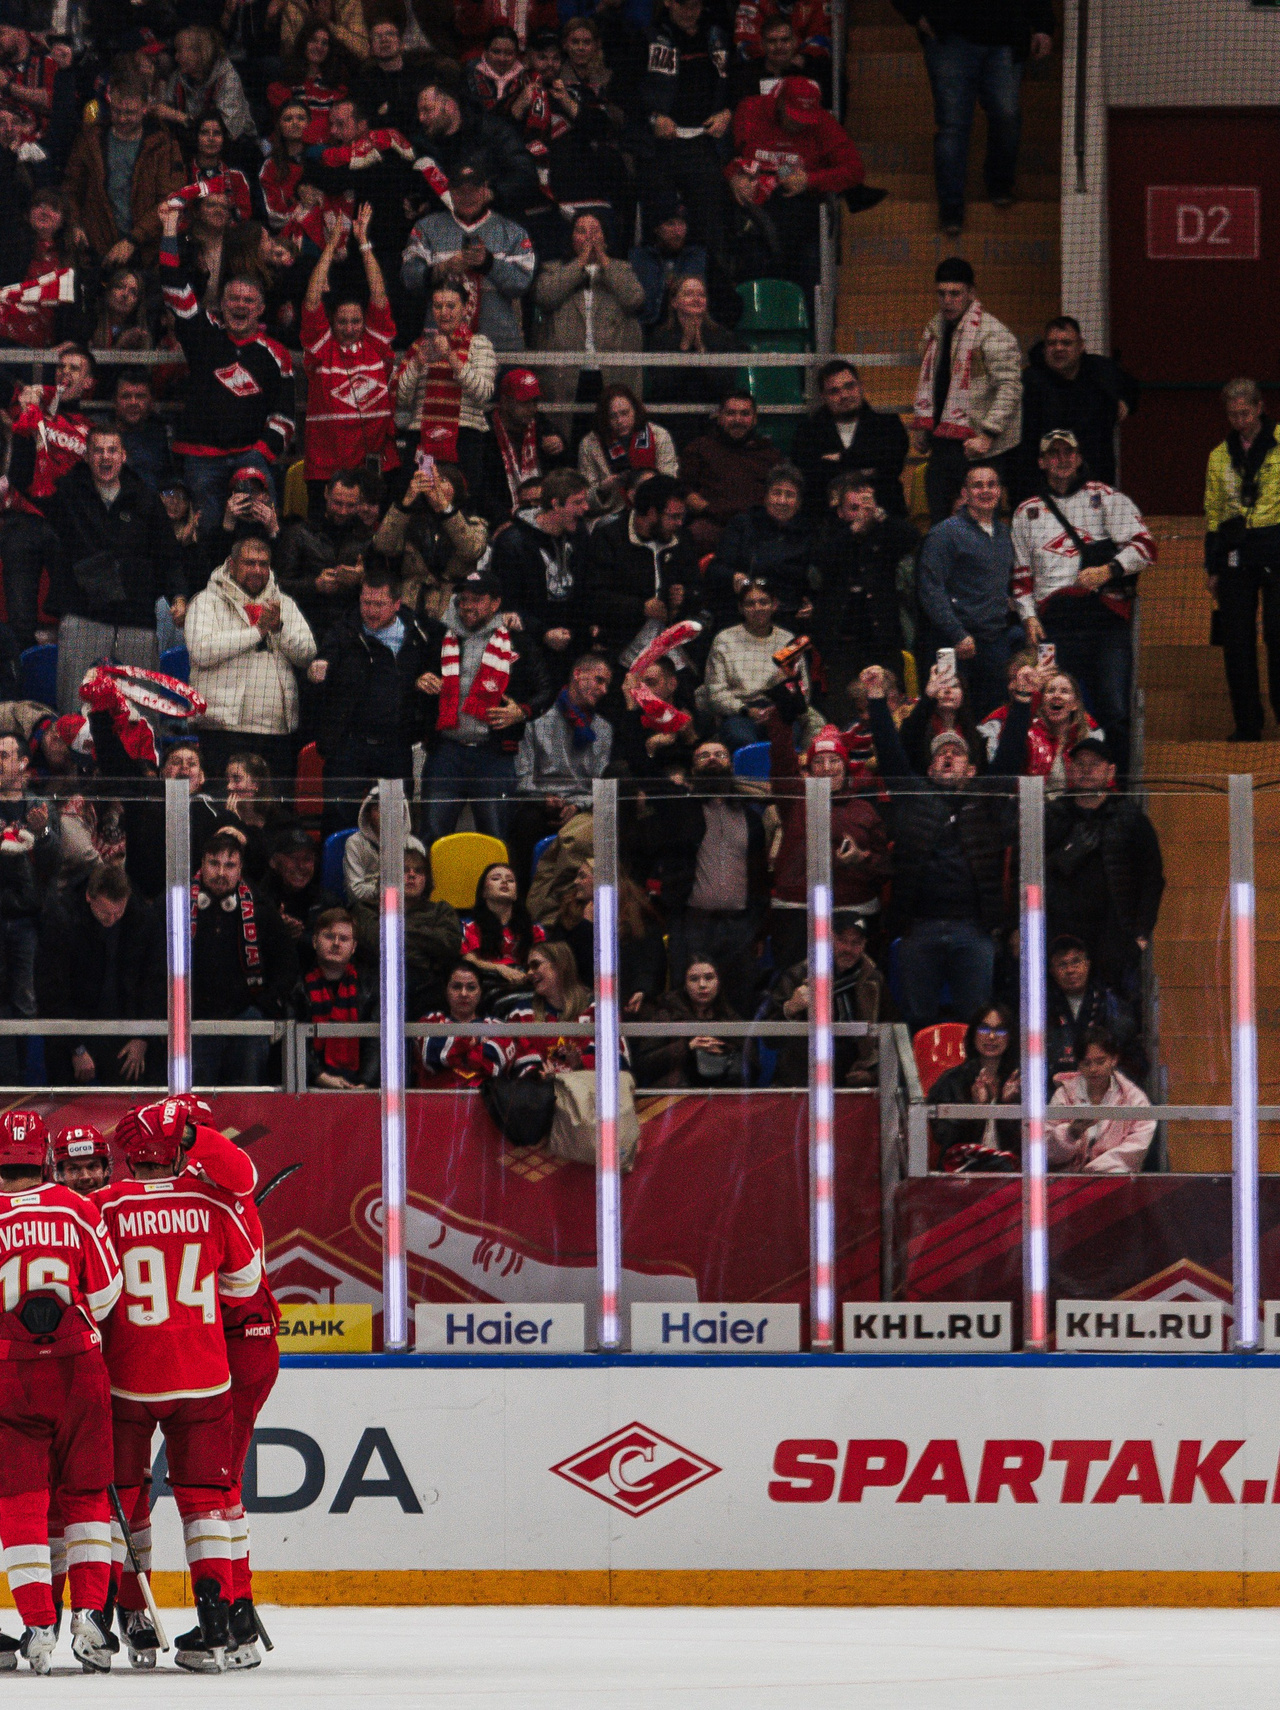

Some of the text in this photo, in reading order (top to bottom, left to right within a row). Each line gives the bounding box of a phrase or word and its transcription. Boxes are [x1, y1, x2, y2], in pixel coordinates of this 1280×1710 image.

[1177, 205, 1231, 243] D2
[13, 1127, 25, 1140] 16
[118, 1208, 210, 1238] MIRONOV
[122, 1242, 216, 1327] 94
[278, 1320, 345, 1336] БАНК
[445, 1311, 555, 1345] Haier
[661, 1311, 768, 1345] Haier
[853, 1314, 1001, 1340] KHL.RU
[1066, 1313, 1213, 1340] KHL.RU
[767, 1438, 1280, 1505] SPARTAK.
